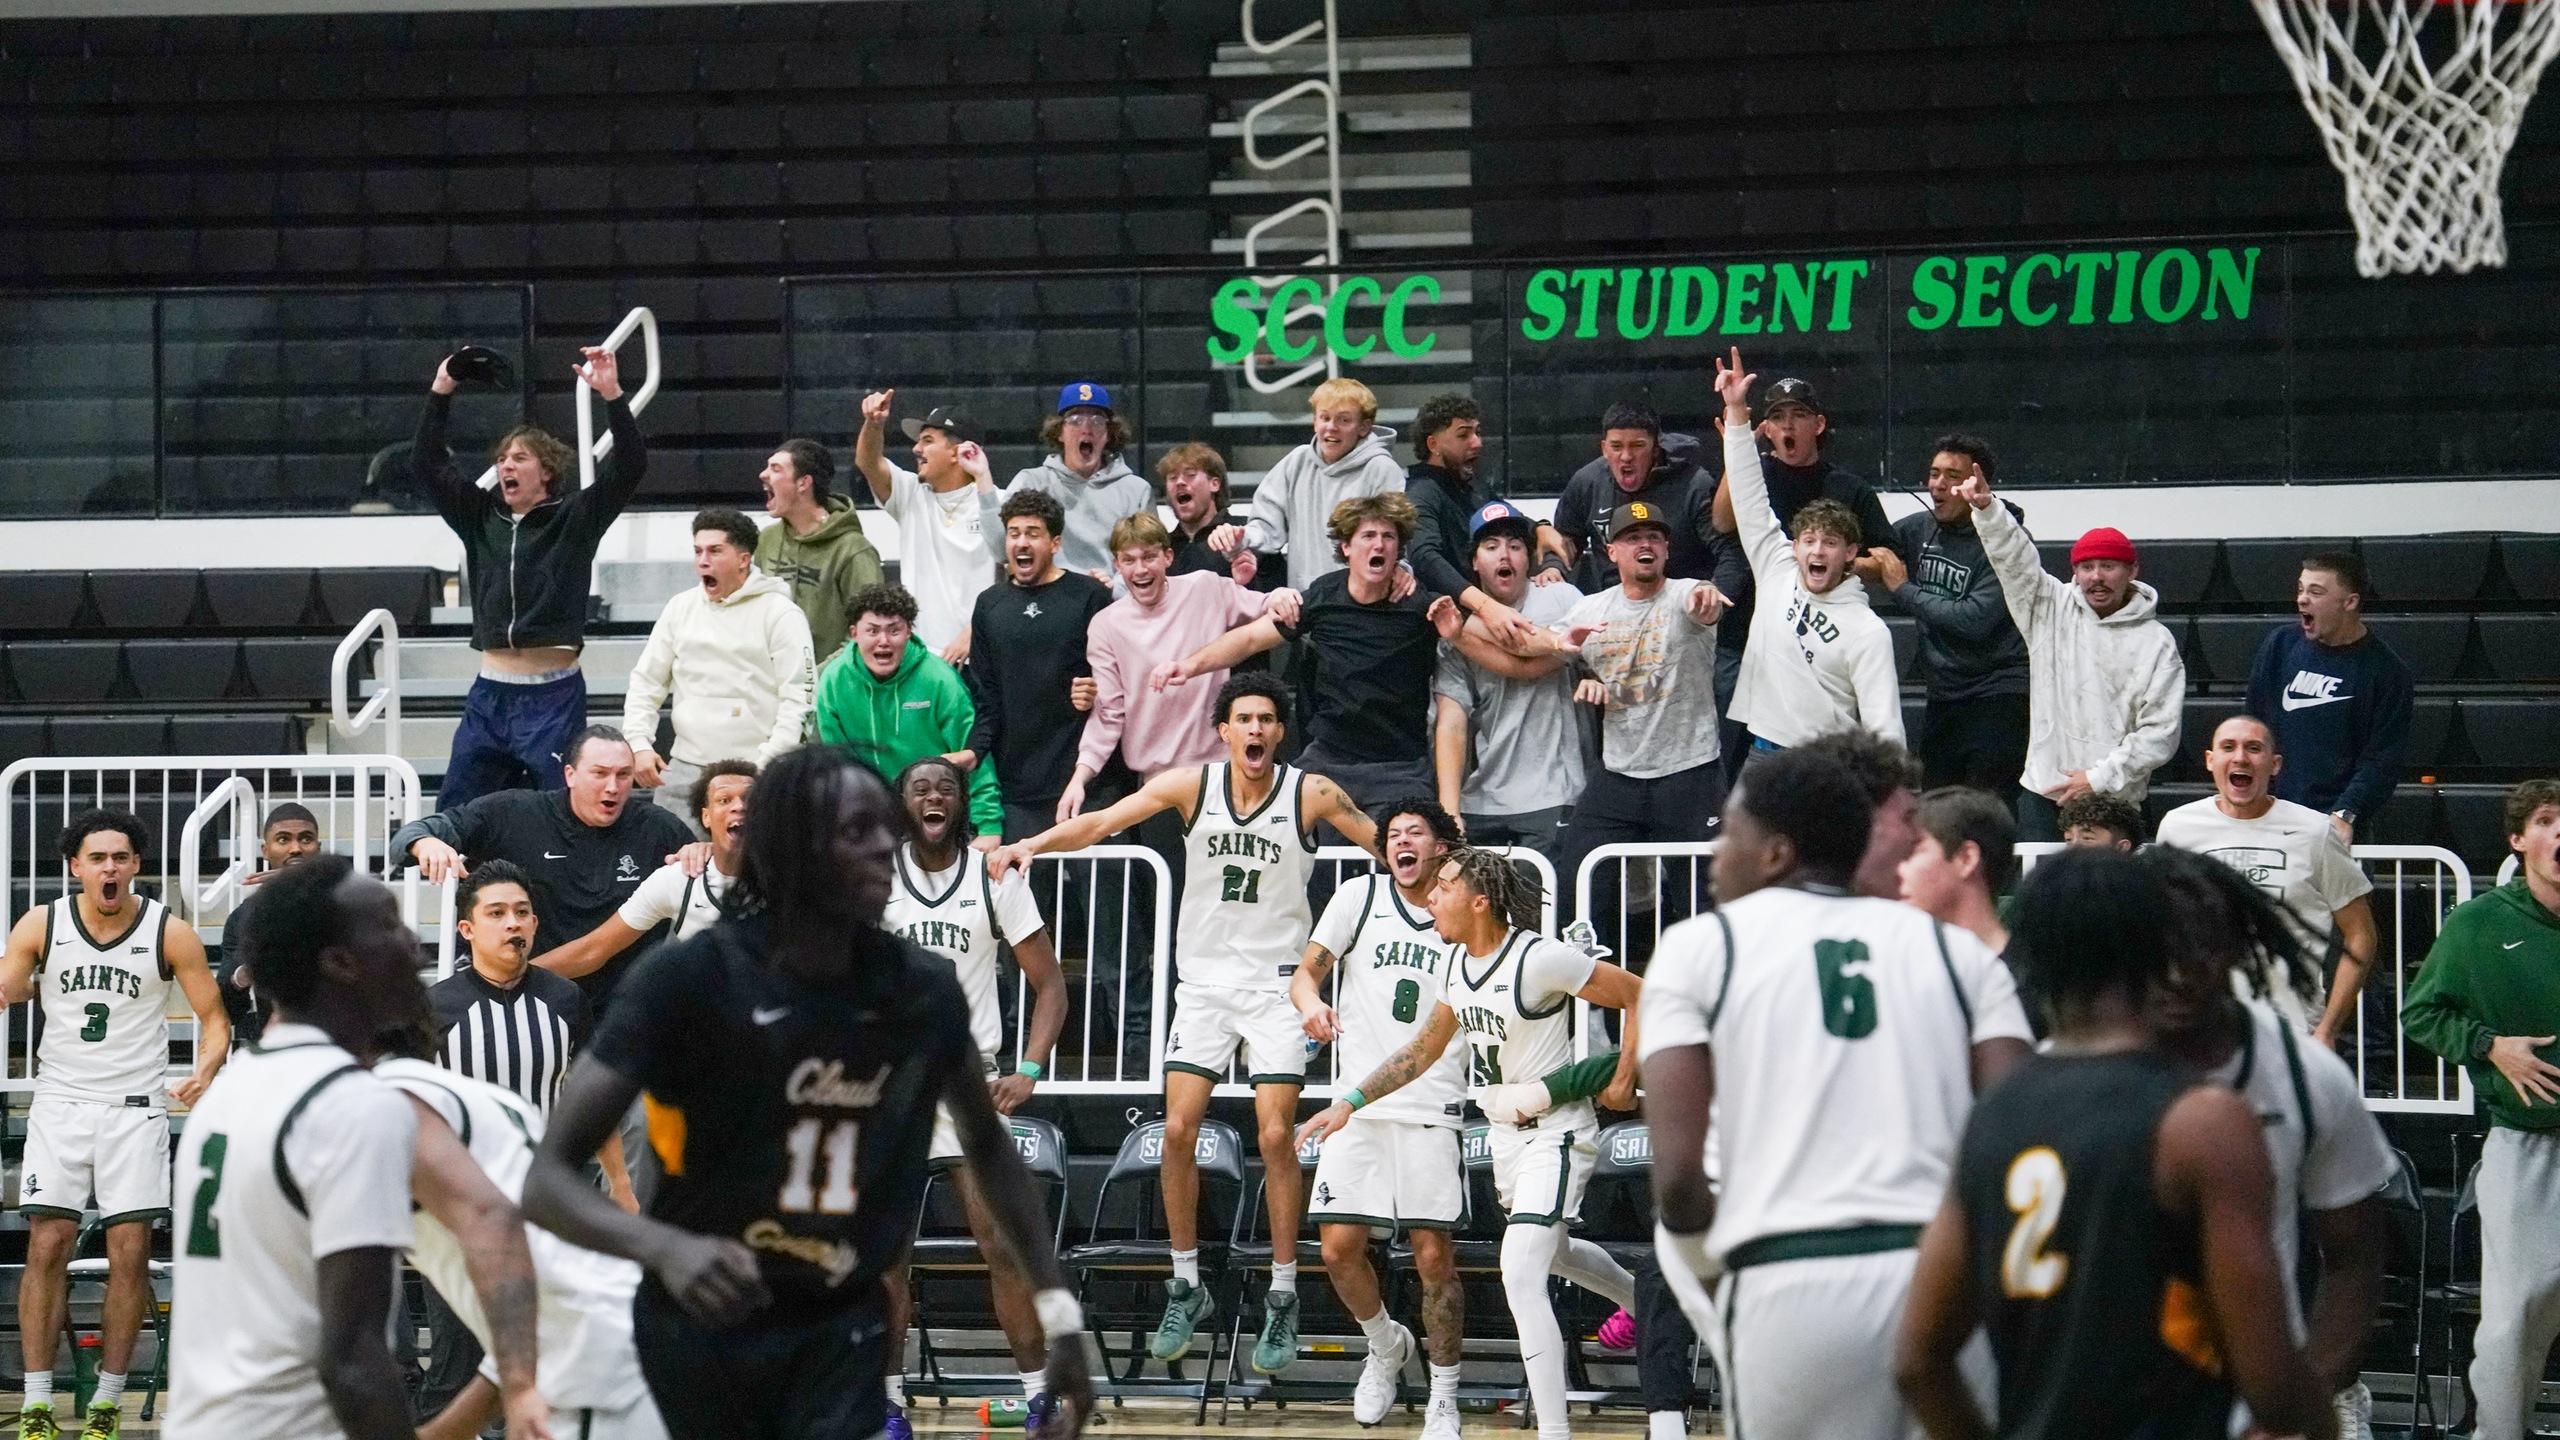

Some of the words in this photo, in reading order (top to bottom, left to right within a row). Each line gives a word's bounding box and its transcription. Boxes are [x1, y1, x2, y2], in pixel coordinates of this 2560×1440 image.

[1207, 274, 1441, 364] SCCC
[1521, 260, 1868, 341] STUDENT
[1907, 247, 2260, 330] SECTION
[2289, 670, 2344, 699] NIKE
[1207, 832, 1282, 864] SAINTS
[1220, 864, 1262, 904] 21
[60, 964, 142, 1000] SAINTS
[1391, 977, 1421, 1025] 8
[1813, 938, 1879, 1040] 6
[80, 1002, 110, 1042] 3
[777, 1117, 860, 1216] 11
[185, 1131, 229, 1259] 2
[2002, 1144, 2070, 1299] 2
